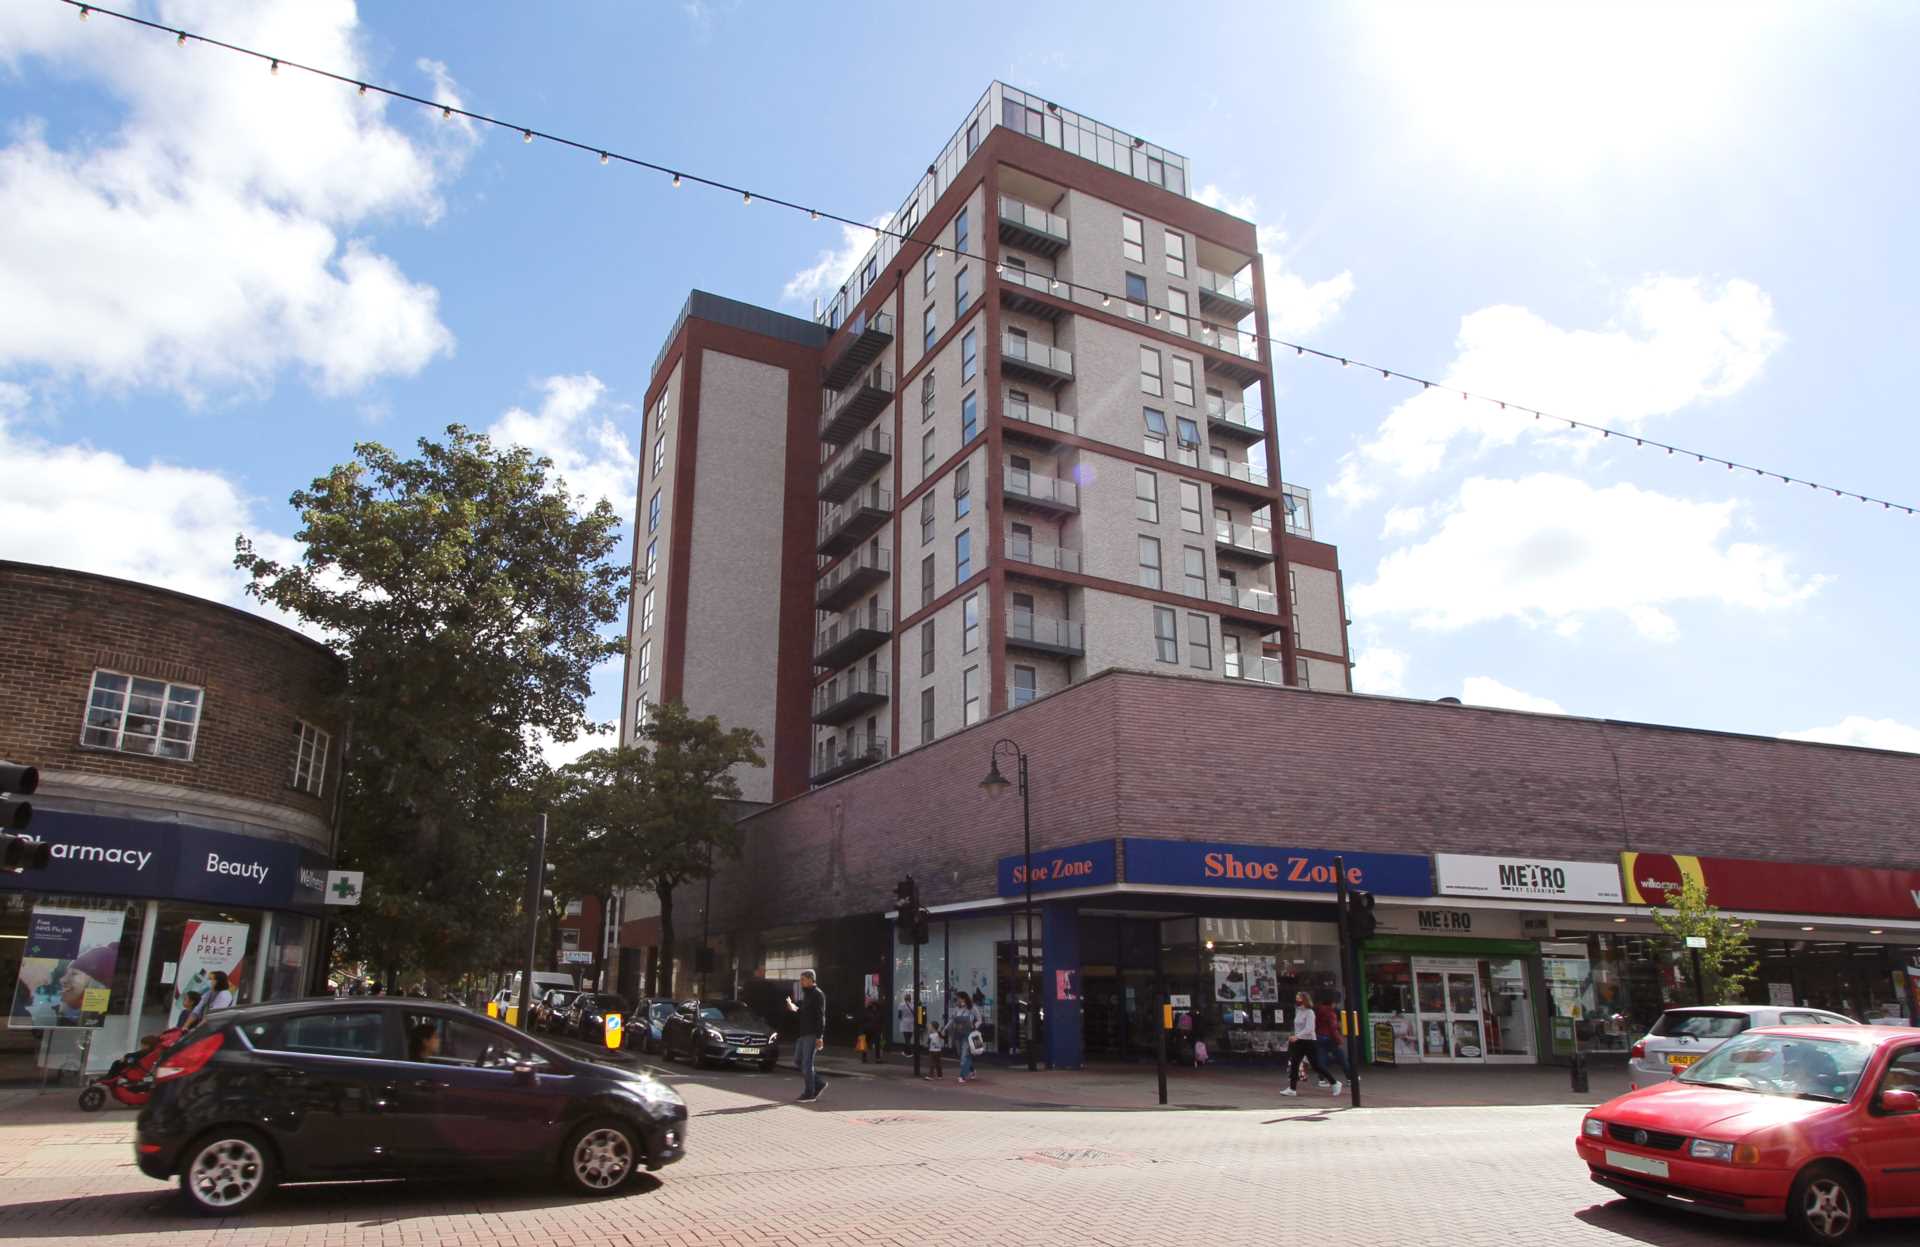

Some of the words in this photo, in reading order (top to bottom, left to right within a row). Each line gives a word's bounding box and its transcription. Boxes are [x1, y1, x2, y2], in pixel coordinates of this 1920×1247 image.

[17, 833, 152, 871] armacy
[206, 852, 269, 885] Beauty
[1051, 858, 1093, 881] Zone
[1204, 852, 1281, 881] Shoe
[1287, 857, 1363, 885] Zone
[1499, 864, 1566, 888] METRO
[197, 944, 233, 957] PRICE
[201, 935, 233, 945] HALF
